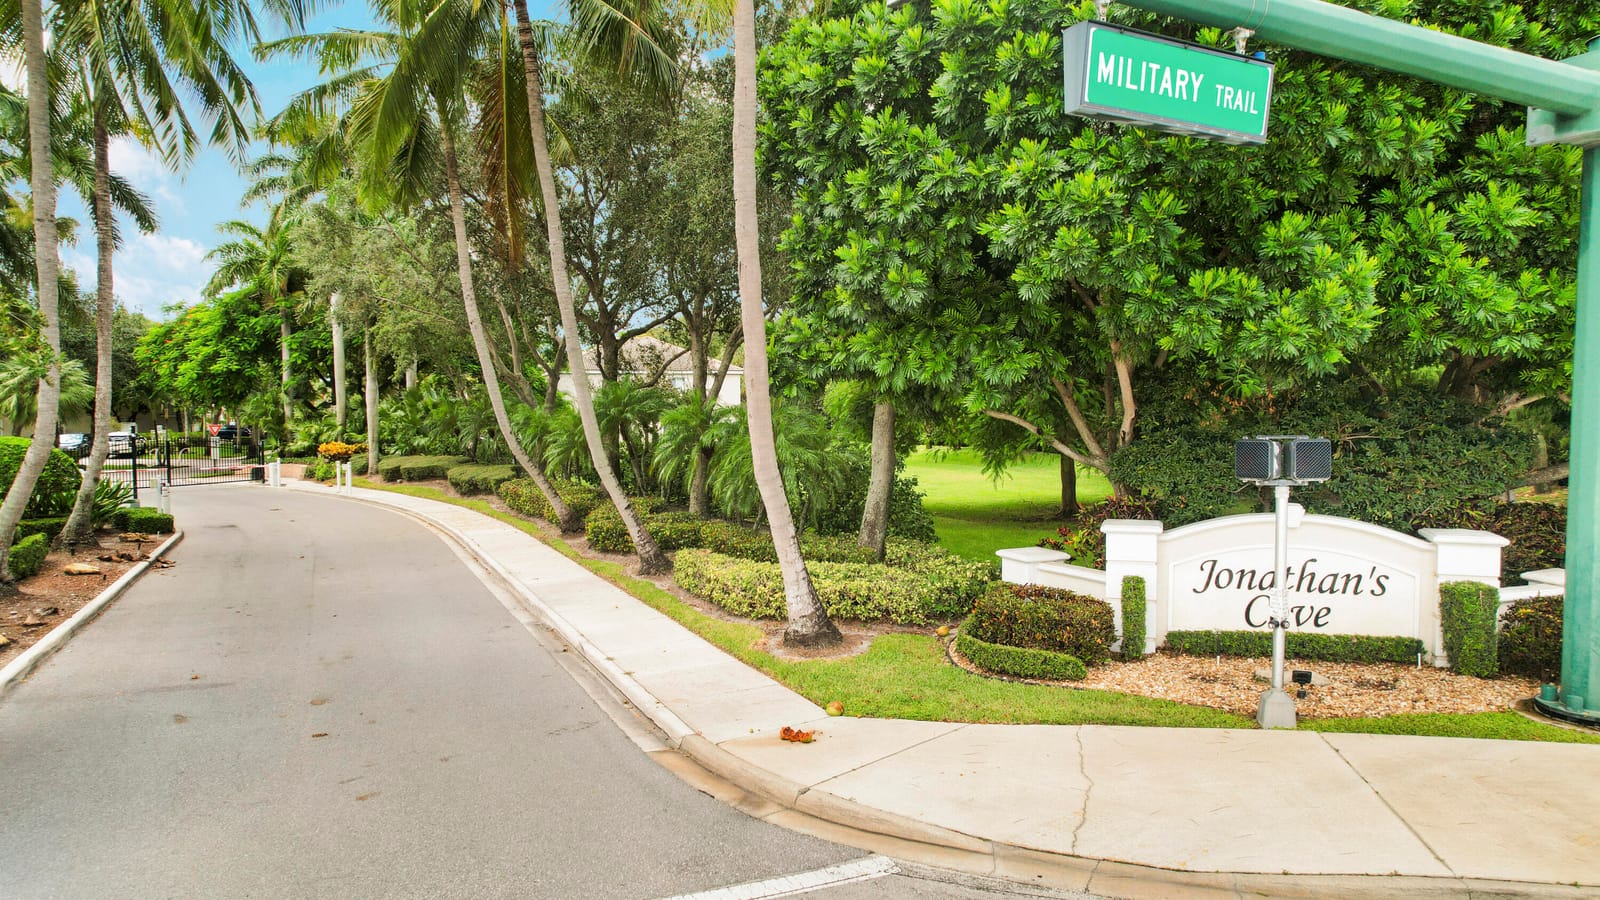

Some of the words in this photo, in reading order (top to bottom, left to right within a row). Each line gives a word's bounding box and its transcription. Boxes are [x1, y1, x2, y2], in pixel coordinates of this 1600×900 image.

[1097, 52, 1204, 102] MILITARY
[1215, 84, 1258, 115] TRAIL
[1244, 594, 1332, 628] Cve
